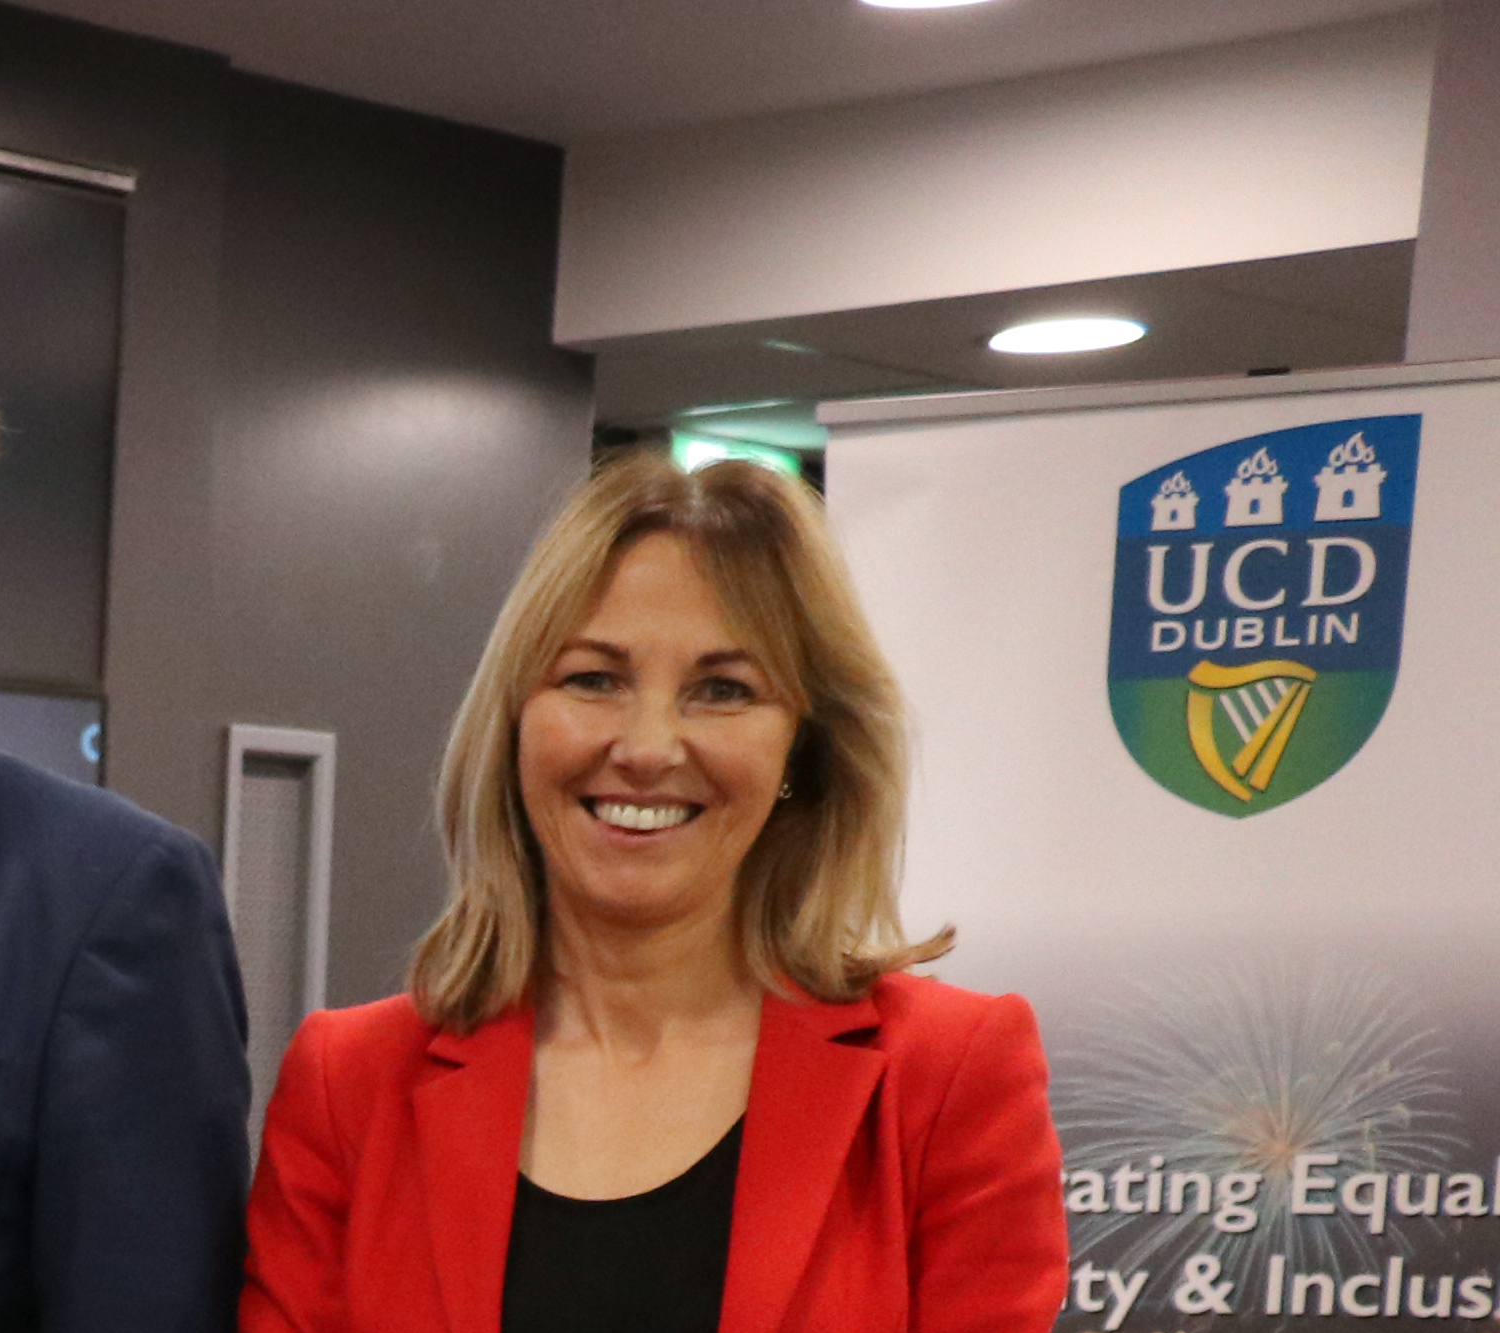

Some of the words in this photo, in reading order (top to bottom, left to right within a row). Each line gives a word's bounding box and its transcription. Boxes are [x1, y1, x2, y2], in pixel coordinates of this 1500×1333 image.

[1146, 536, 1377, 615] UCD
[1150, 612, 1360, 653] DUBLIN
[1062, 1155, 1262, 1233] ating
[1063, 1260, 1149, 1331] ty
[1173, 1254, 1235, 1315] &
[1265, 1254, 1500, 1320] Inclus
